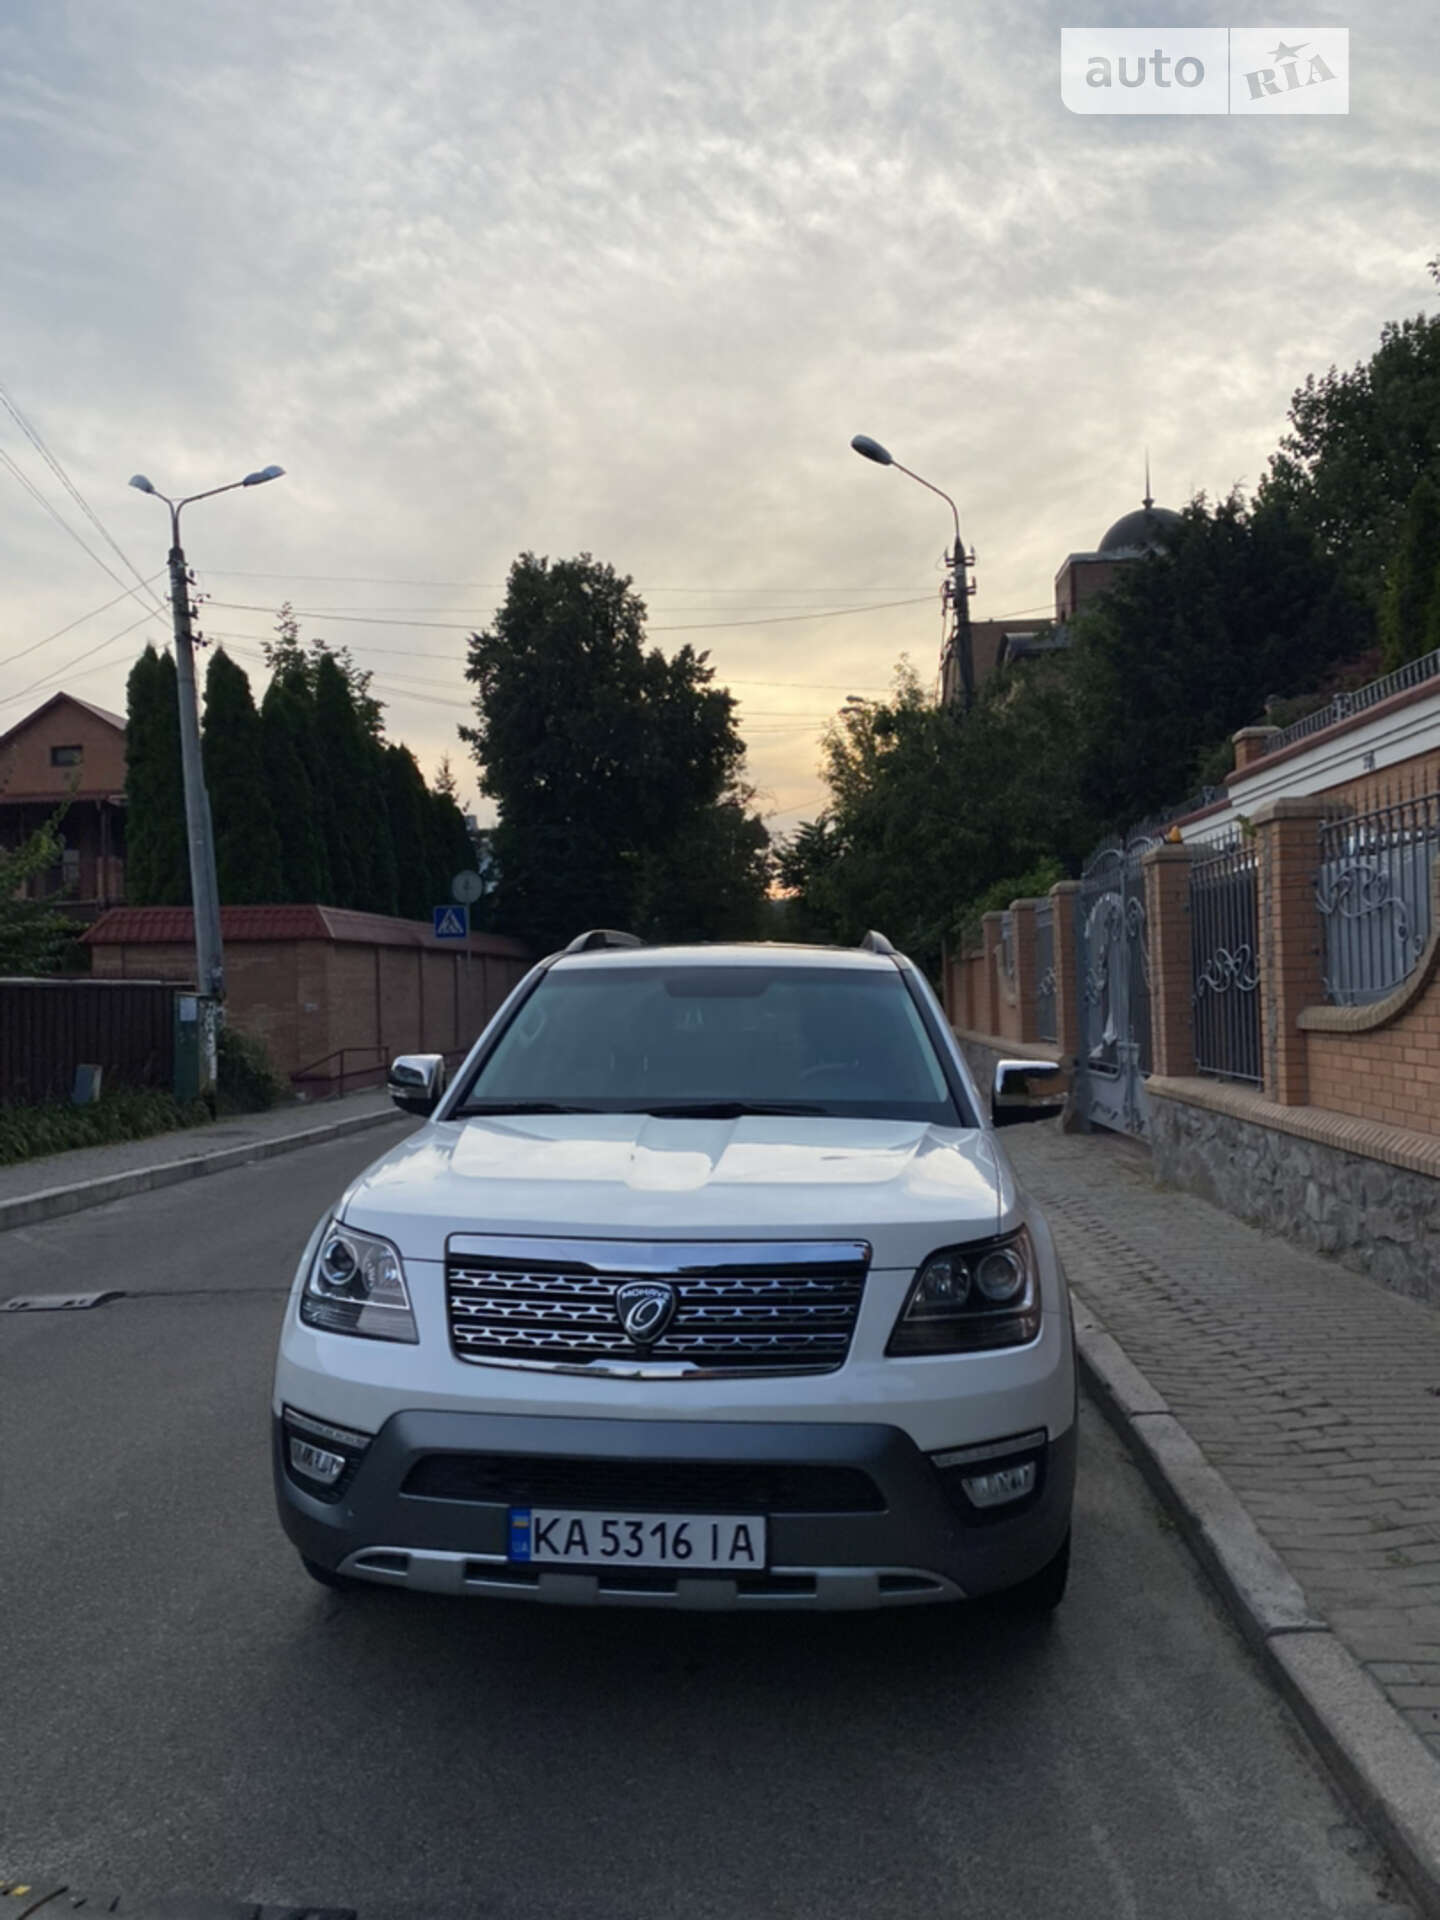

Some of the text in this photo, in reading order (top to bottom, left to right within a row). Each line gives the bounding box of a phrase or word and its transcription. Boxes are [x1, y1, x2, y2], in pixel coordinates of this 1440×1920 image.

[533, 1517, 755, 1562] KA 5316 IA
